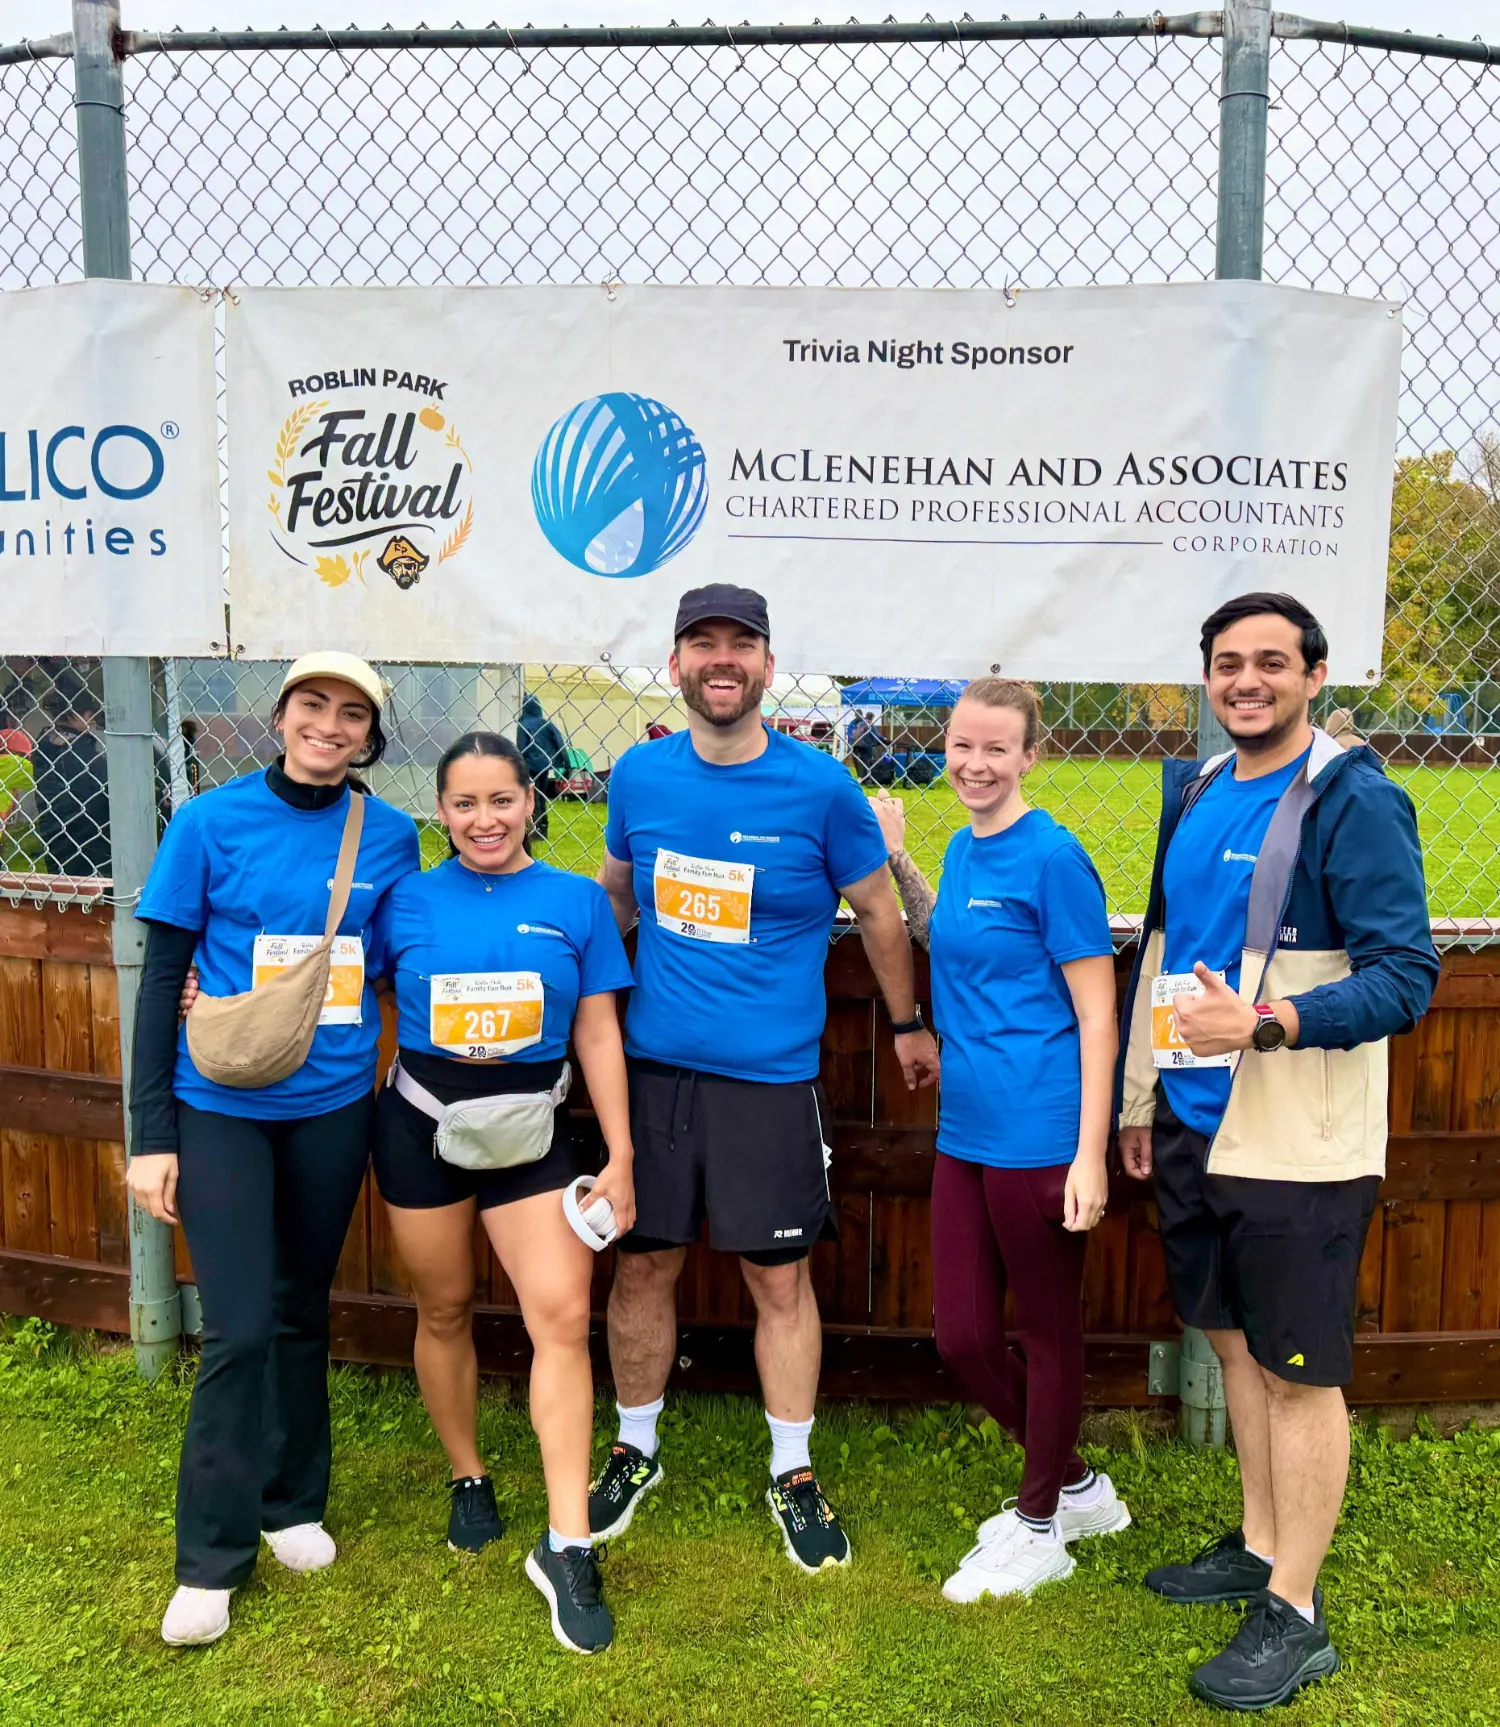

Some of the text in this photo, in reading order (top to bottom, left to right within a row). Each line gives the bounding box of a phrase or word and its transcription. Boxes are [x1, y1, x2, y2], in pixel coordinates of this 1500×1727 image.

[782, 338, 1075, 370] Trivia Night Sponsor
[288, 368, 449, 401] ROBLIN PARK
[300, 409, 418, 471] Fall
[1007, 457, 1102, 487] AND
[1115, 451, 1348, 492] ASSOCIATES
[286, 462, 463, 533] Festival
[726, 495, 1344, 529] CHARTERED PROFESSIONAL ACCOUNTANTS
[0, 518, 167, 557] nities
[1172, 535, 1338, 556] CORPORATION
[728, 869, 745, 882] 5k
[678, 889, 721, 921] 265
[339, 943, 357, 956] 5k
[516, 978, 535, 991] 5k
[464, 1009, 512, 1039] 267
